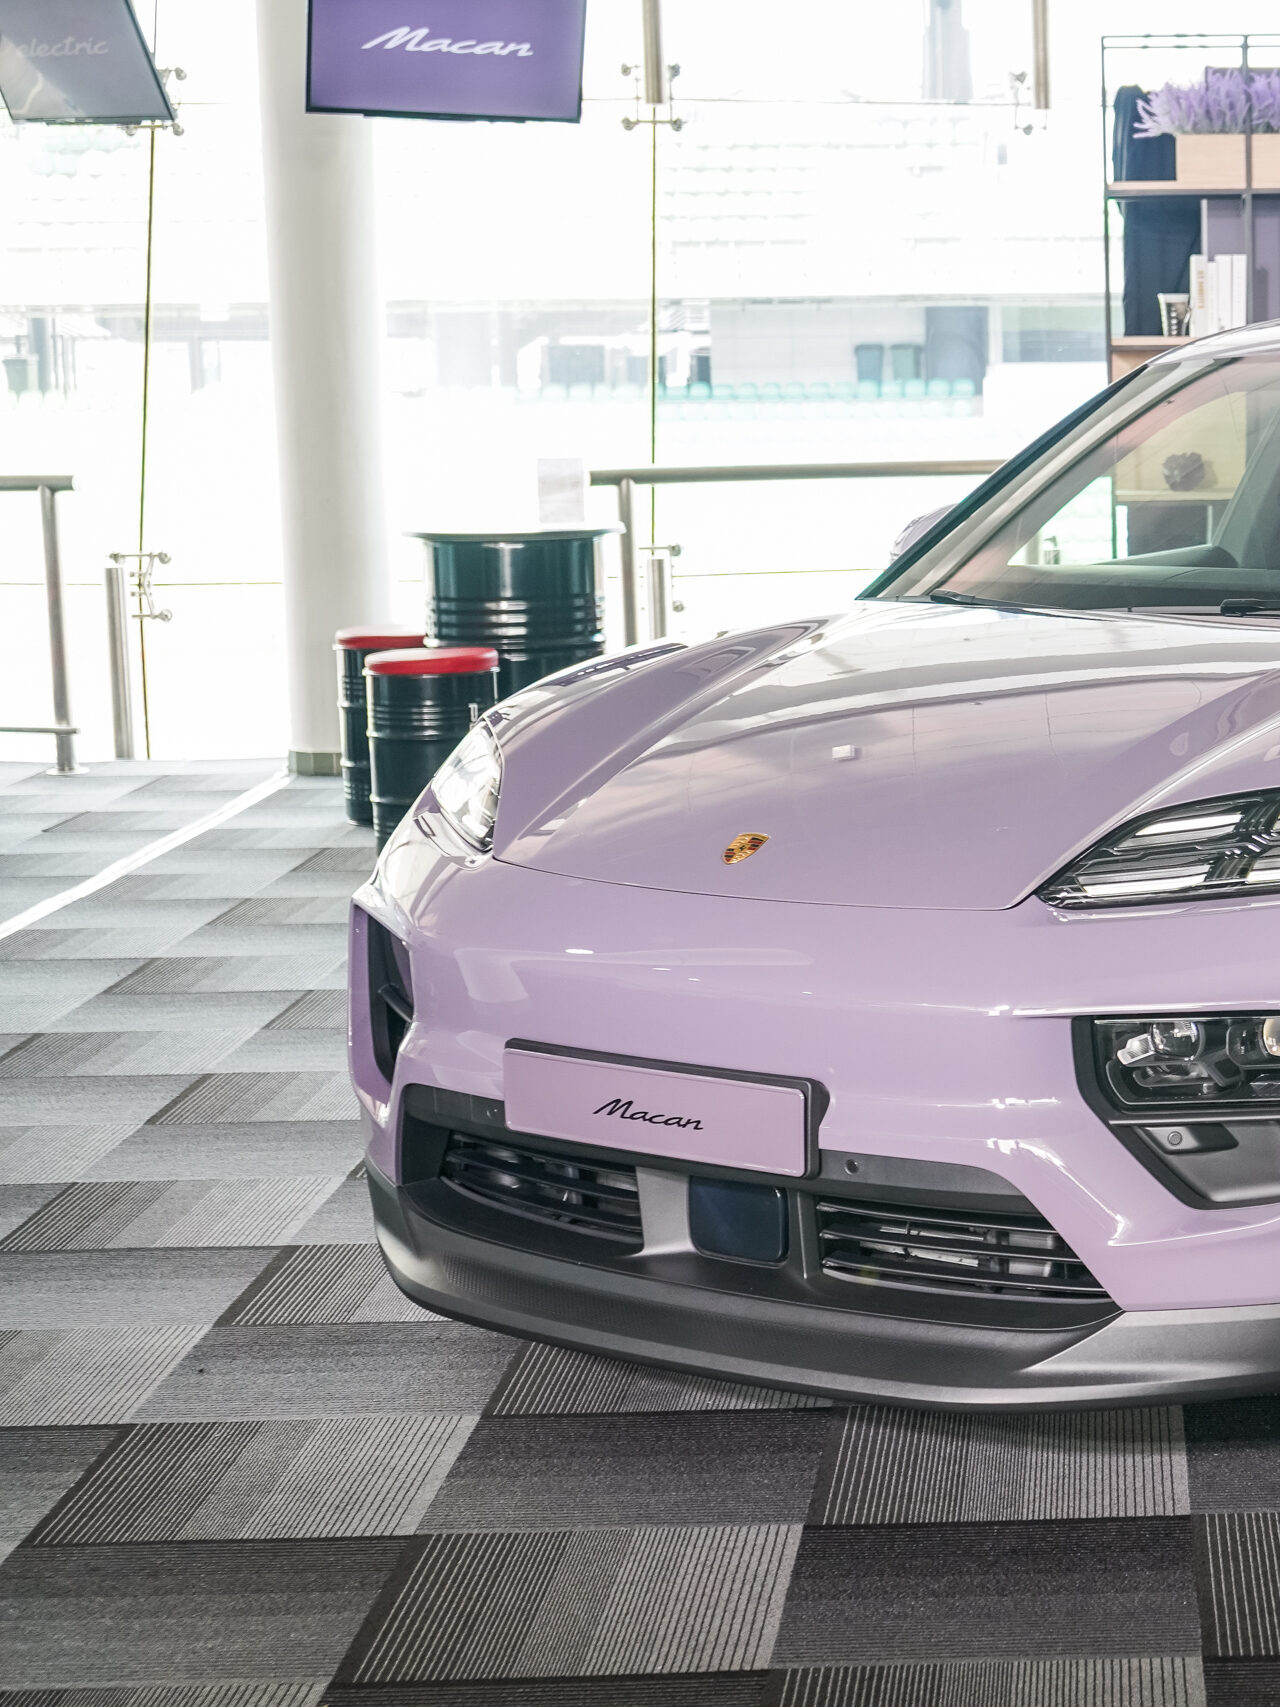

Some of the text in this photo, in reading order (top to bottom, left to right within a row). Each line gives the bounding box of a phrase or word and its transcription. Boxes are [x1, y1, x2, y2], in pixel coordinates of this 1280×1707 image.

[16, 36, 109, 57] electric
[361, 26, 534, 57] Macan
[593, 1098, 703, 1130] Macan
